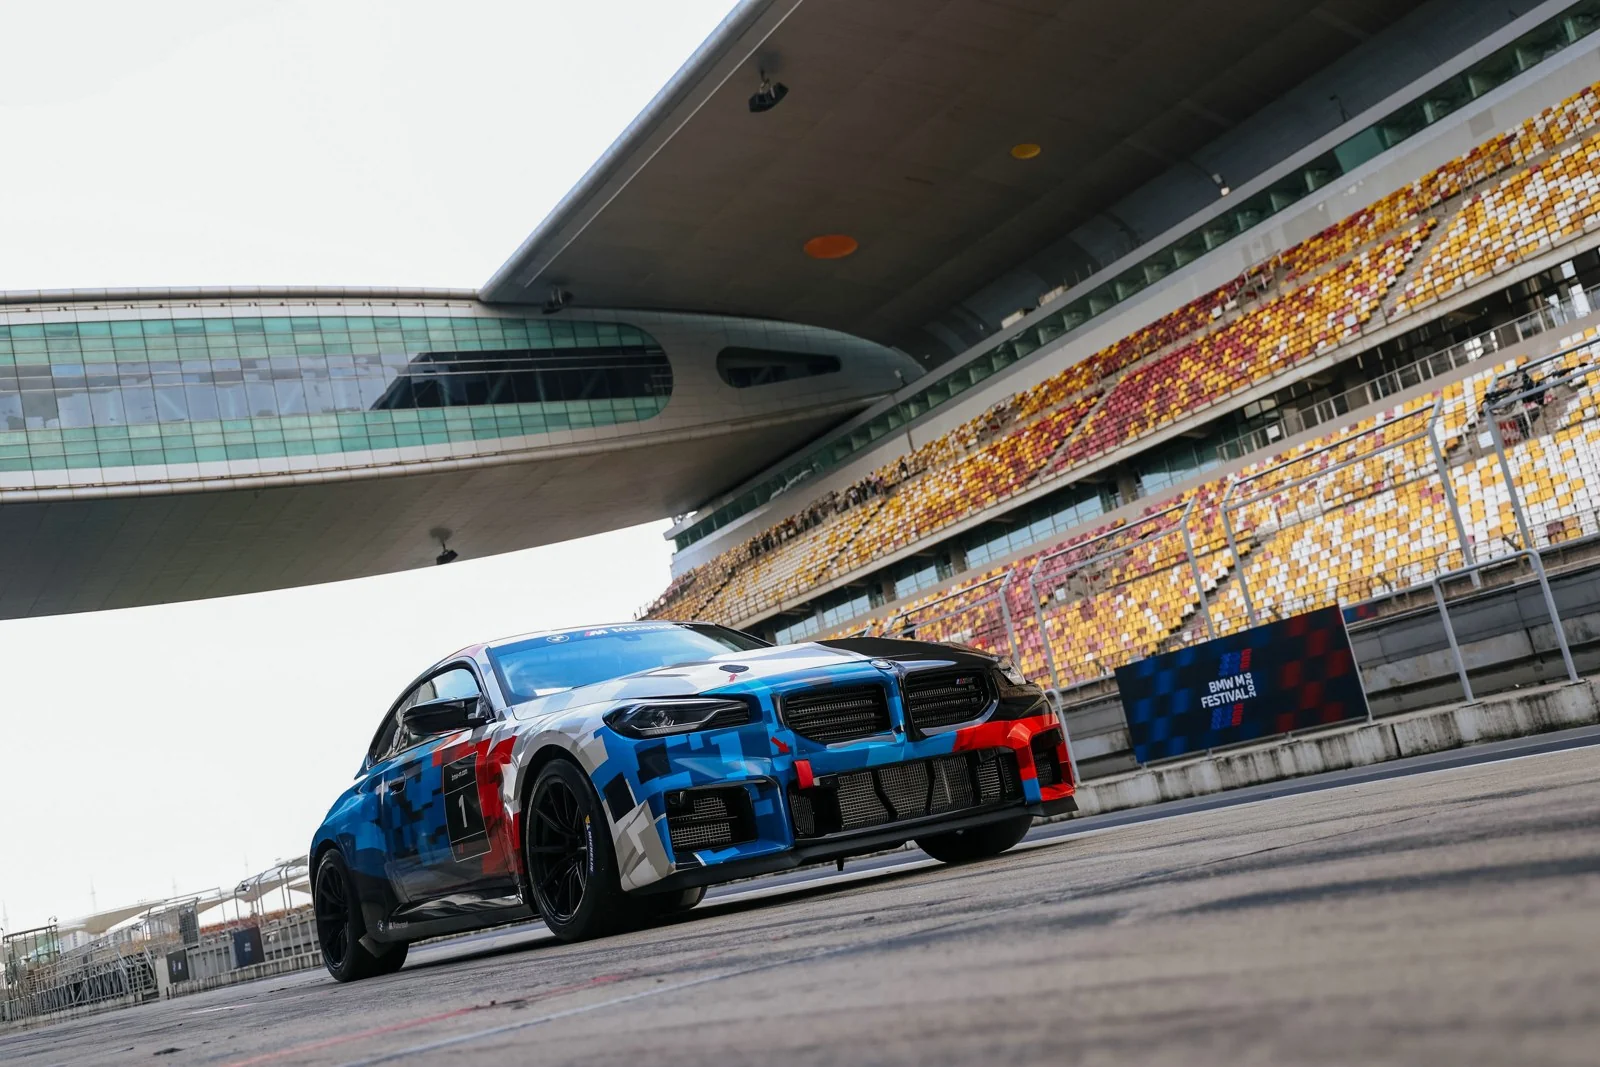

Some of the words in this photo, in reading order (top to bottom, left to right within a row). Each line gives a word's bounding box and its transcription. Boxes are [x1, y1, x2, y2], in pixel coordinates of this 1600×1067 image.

[1208, 677, 1234, 693] BMW
[1234, 674, 1245, 687] M
[1244, 672, 1257, 698] 2026
[1201, 688, 1249, 708] FESTIVAL
[459, 795, 468, 828] 1
